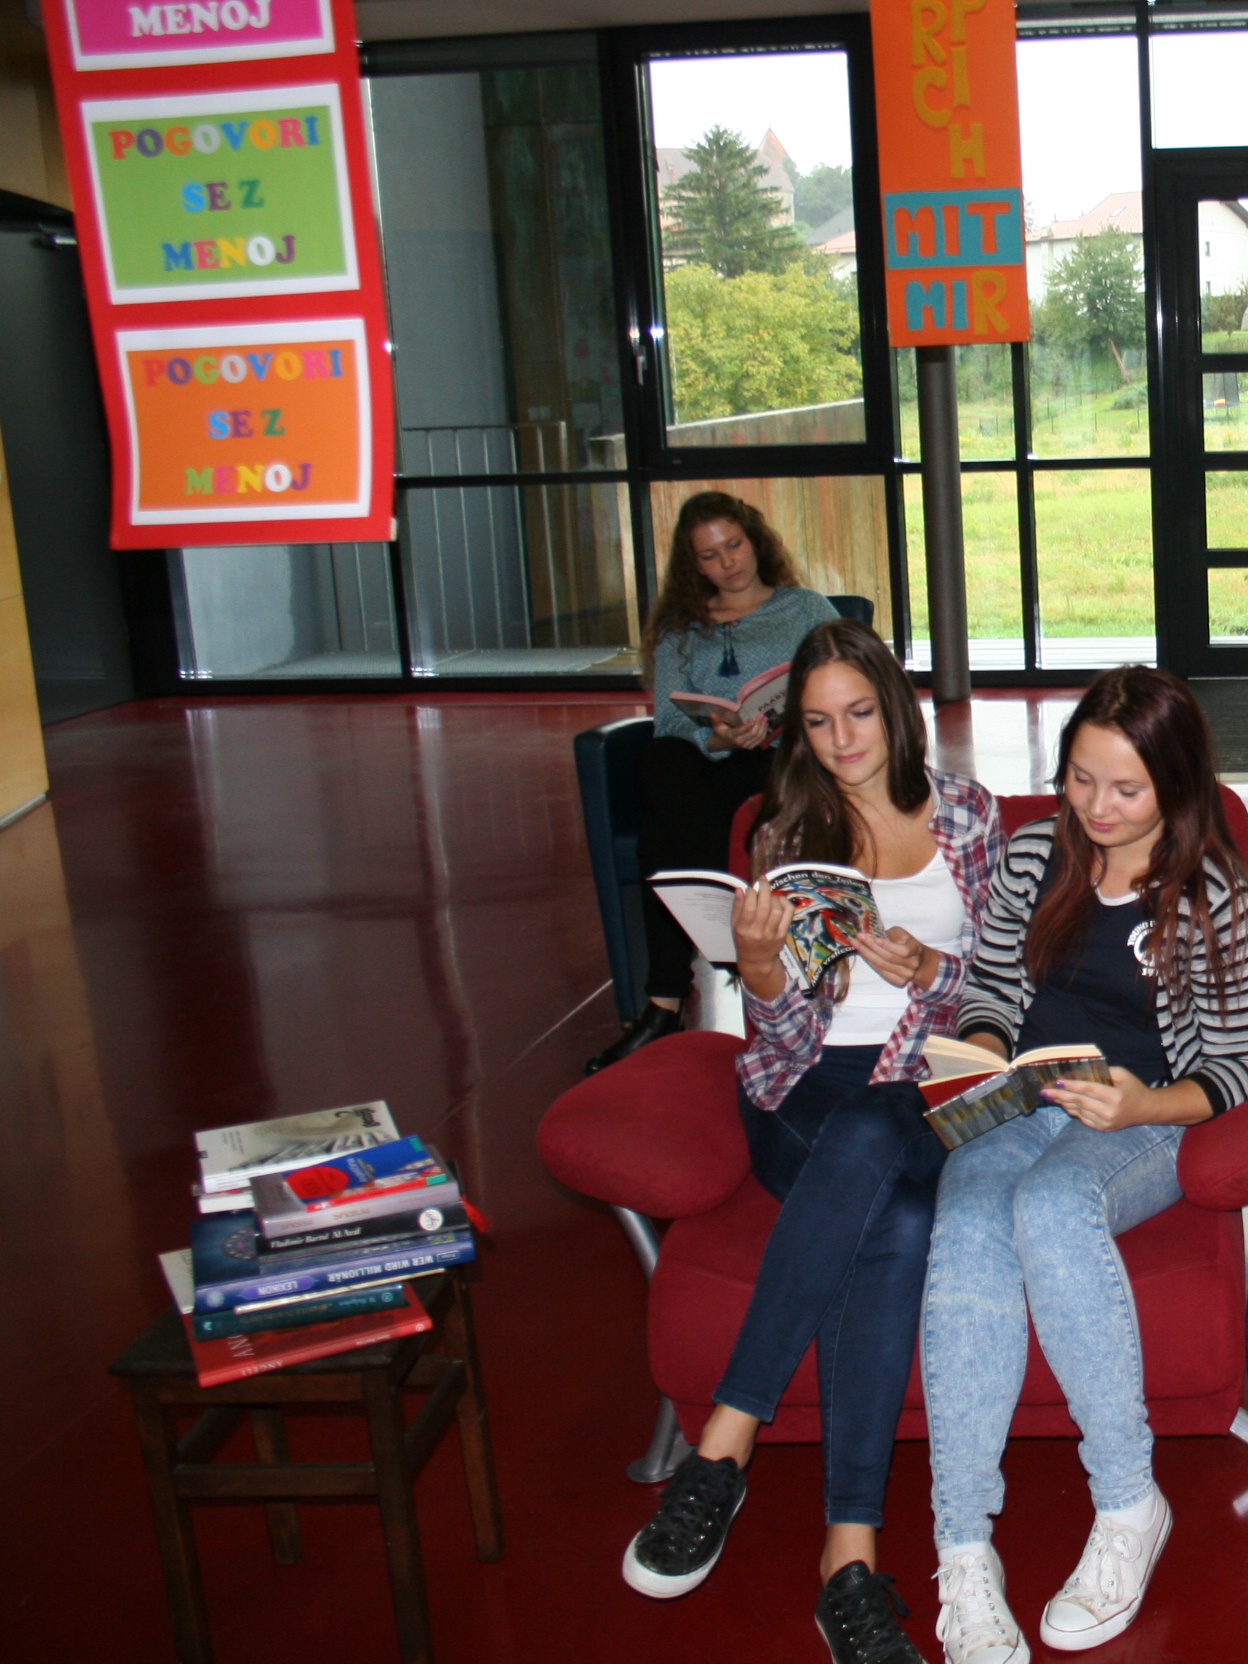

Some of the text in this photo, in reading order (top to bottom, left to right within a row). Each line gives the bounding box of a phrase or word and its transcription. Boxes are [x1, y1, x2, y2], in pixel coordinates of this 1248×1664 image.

[129, 0, 271, 38] MENOJ
[109, 115, 320, 160] POGOVORI
[181, 179, 264, 213] SE Z
[893, 201, 1011, 258] MIT
[161, 235, 297, 272] MENOJ
[904, 268, 1011, 336] MIR
[143, 348, 344, 388] POGOVORI
[207, 409, 286, 440] SE Z
[184, 463, 313, 497] MENOJ
[326, 1263, 382, 1283] MILLIONÄR
[384, 1259, 412, 1272] WIRD
[412, 1254, 435, 1267] WER
[258, 1280, 299, 1297] LEXIKON
